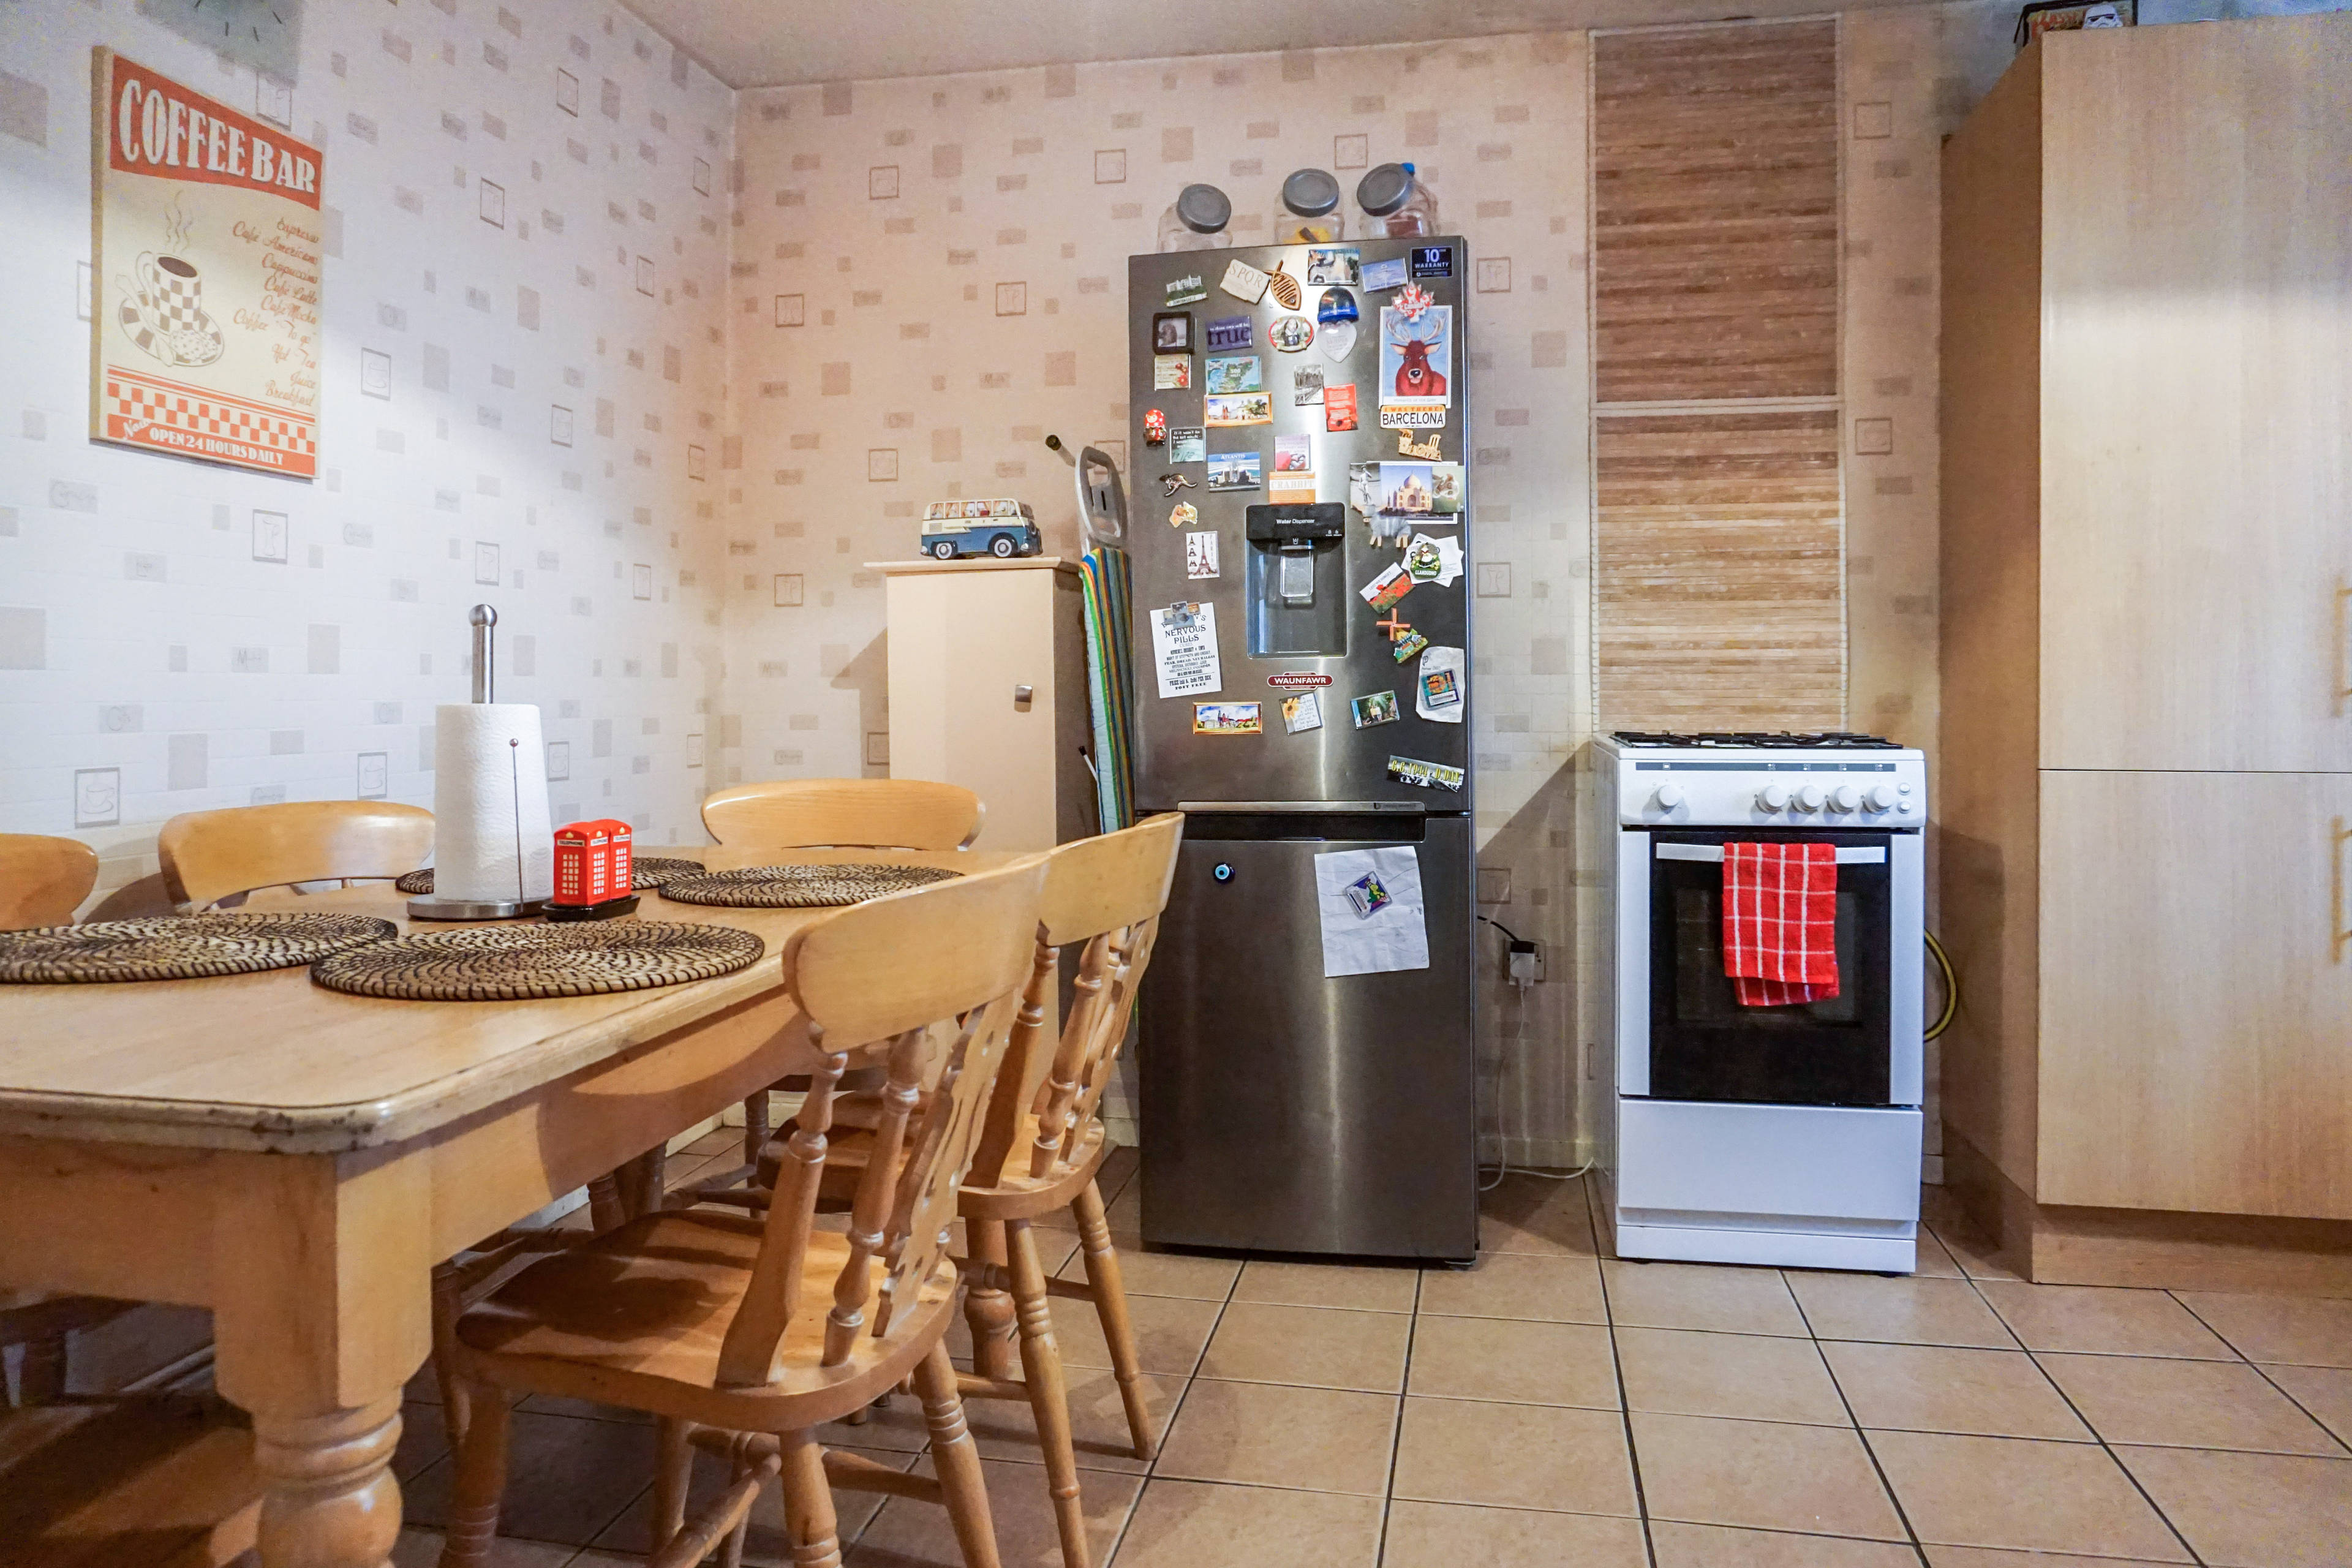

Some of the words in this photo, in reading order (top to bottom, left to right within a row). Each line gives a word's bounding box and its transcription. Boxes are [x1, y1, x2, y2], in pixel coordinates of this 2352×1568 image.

[119, 80, 245, 176] COFFEE
[251, 137, 315, 194] BAR
[1424, 248, 1440, 263] 10
[1229, 261, 1264, 288] SPQR
[293, 287, 317, 304] Latte
[233, 308, 268, 331] Coffee
[287, 303, 316, 325] Mocha
[1208, 328, 1250, 345] true
[272, 344, 291, 363] Hot
[295, 348, 316, 369] Tea
[290, 371, 316, 389] Juice
[265, 380, 315, 407] Breakfast
[1382, 412, 1444, 425] BARCELONA
[149, 428, 185, 445] OPEN
[186, 435, 203, 450] 24
[205, 439, 247, 458] HOURS
[247, 447, 283, 465] DAILY
[1272, 480, 1314, 489] CRABBIT
[1165, 625, 1206, 638] NERVOUS
[1174, 634, 1199, 644] PILLS
[1391, 760, 1428, 777] 6.6.1944
[1434, 767, 1460, 783] D.DAY
